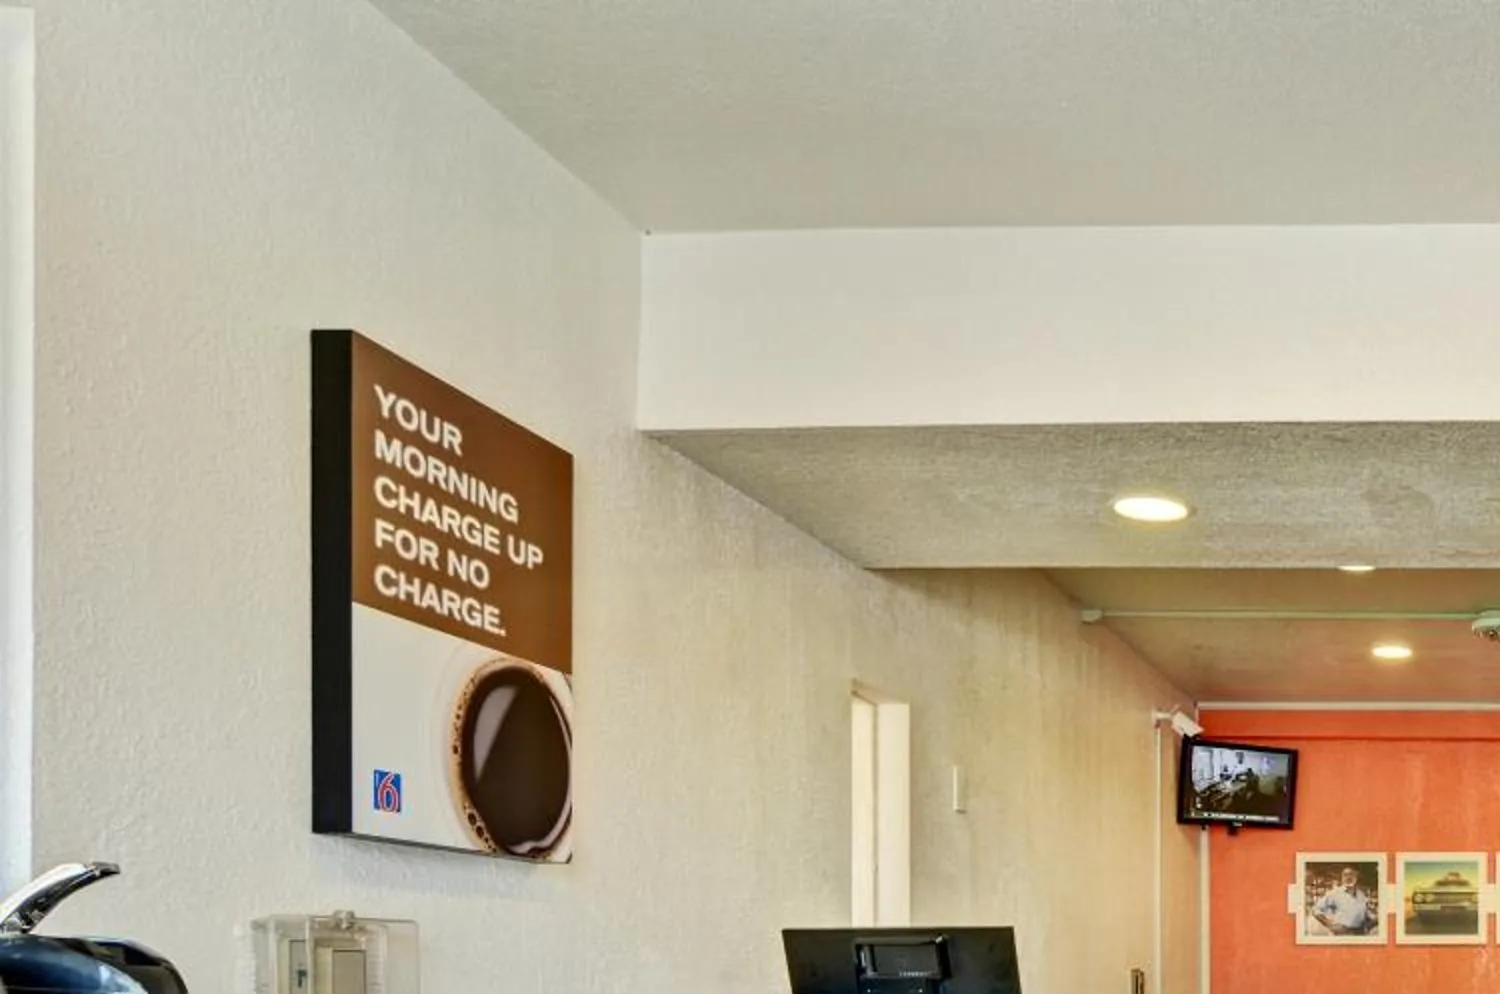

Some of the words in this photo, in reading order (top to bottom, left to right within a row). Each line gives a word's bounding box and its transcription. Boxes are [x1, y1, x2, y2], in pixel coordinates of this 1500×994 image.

[374, 384, 463, 457] YOUR
[374, 429, 519, 524] MORNING
[373, 475, 501, 556] CHARGE
[506, 534, 544, 570] UP
[374, 518, 440, 572] FOR
[446, 548, 491, 590] NO
[373, 563, 507, 637] CHARGE.
[378, 771, 399, 813] 6
